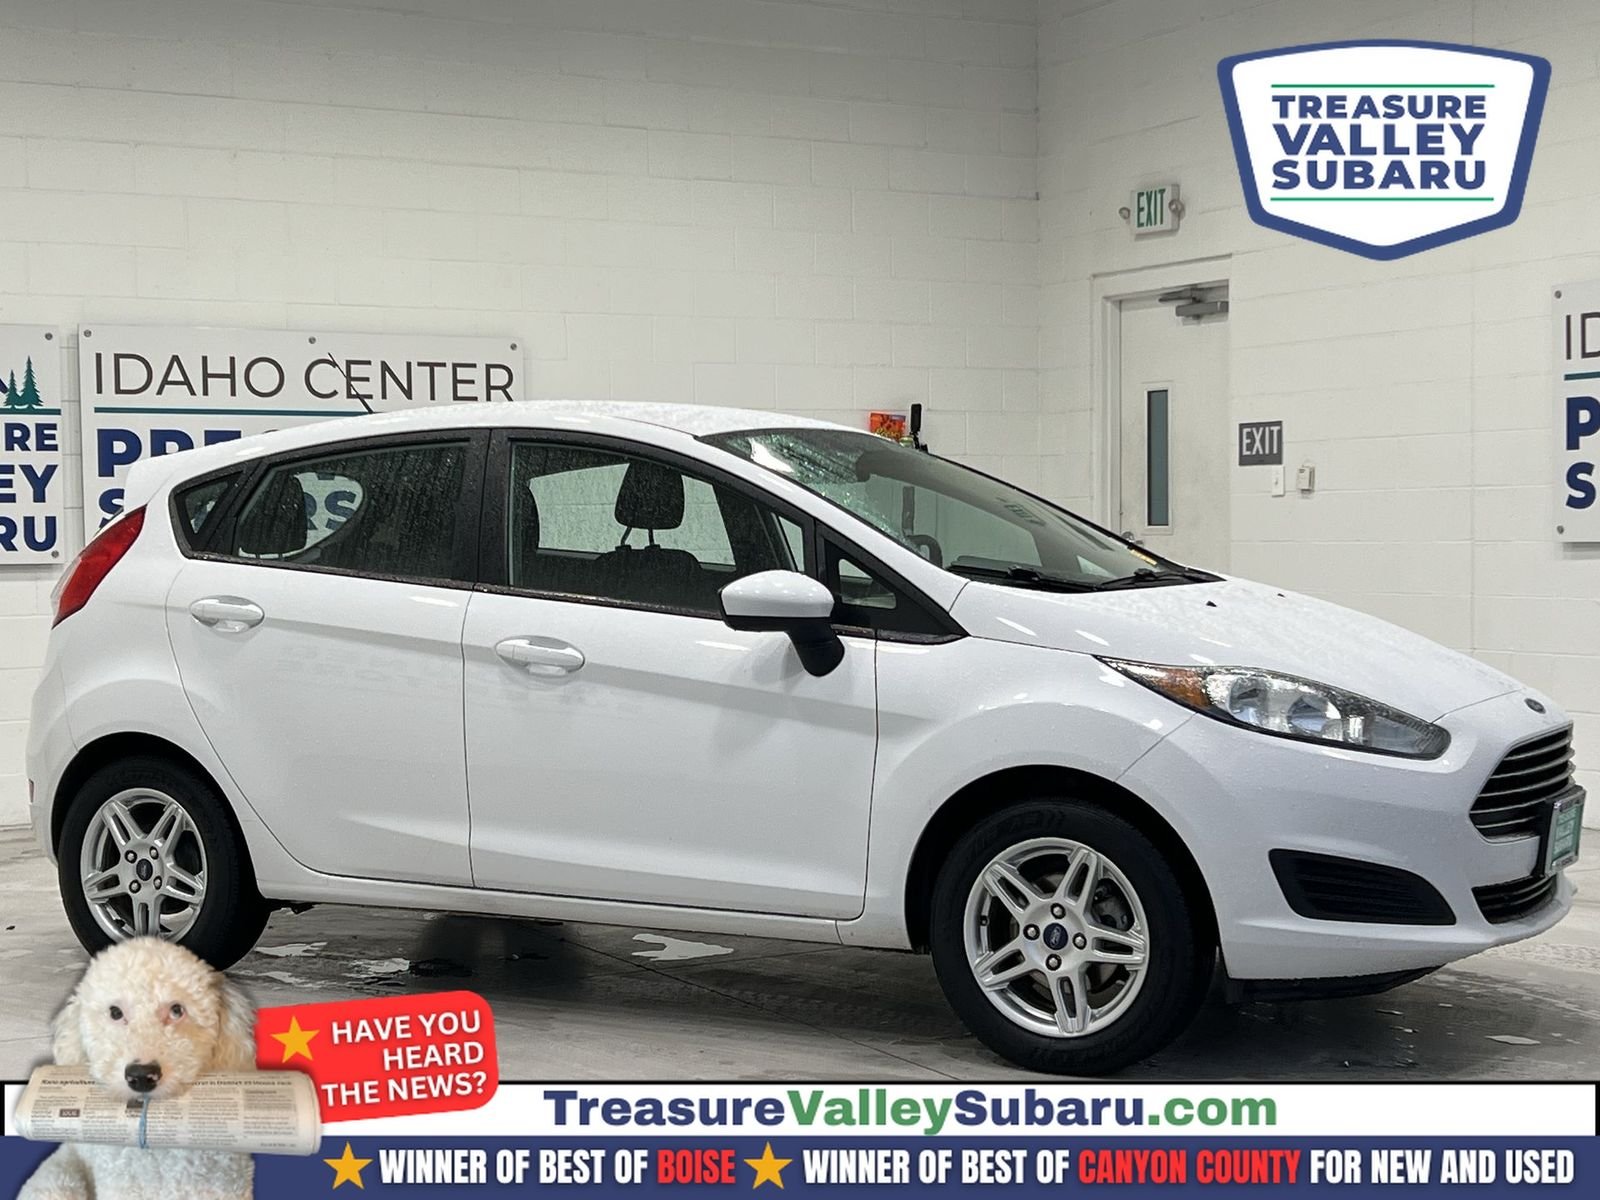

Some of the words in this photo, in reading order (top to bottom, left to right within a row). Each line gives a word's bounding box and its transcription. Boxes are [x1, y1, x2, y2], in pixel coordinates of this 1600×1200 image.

[1136, 188, 1166, 228] EXIT
[94, 352, 285, 398] IDAHO
[303, 355, 515, 401] CENTER
[1242, 425, 1281, 456] EXIT
